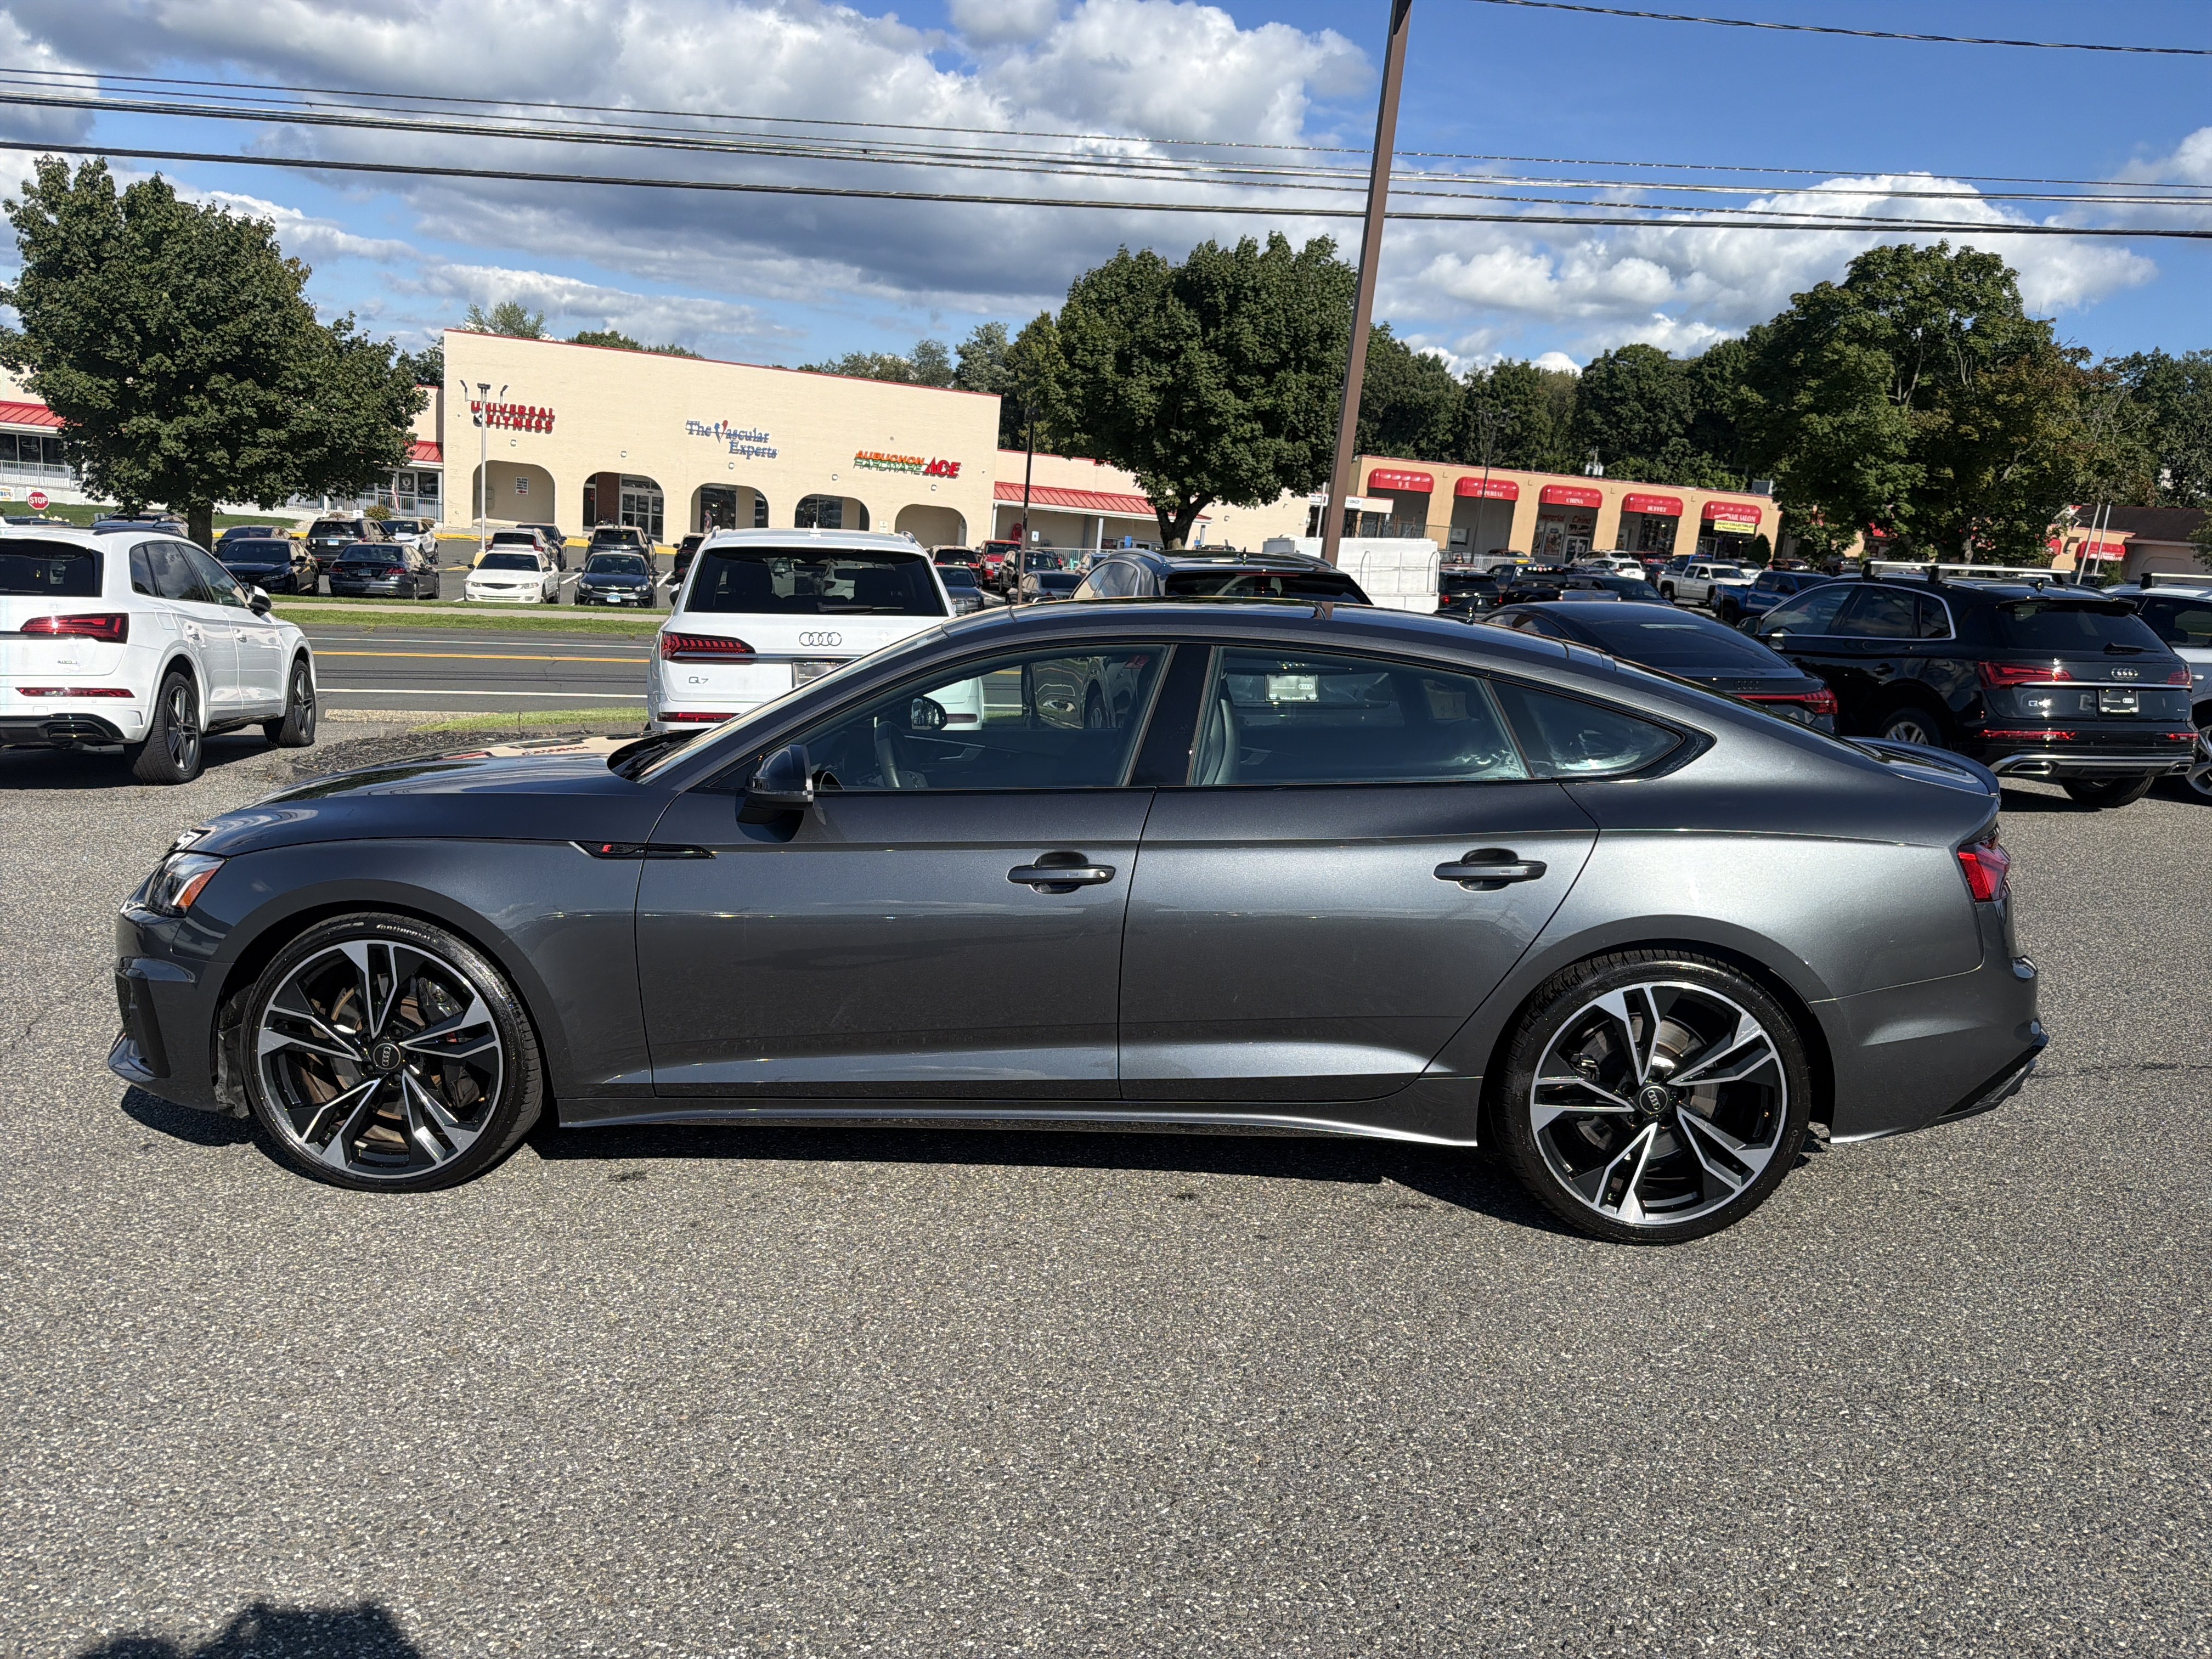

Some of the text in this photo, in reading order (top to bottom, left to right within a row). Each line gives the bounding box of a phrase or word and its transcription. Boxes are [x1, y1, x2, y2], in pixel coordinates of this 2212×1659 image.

[471, 400, 556, 420] UNIVERSAL
[487, 415, 553, 432] FITNESS
[685, 420, 770, 443] The Vascular
[729, 440, 778, 460] Experts
[855, 450, 925, 465] AUBUCHON
[854, 459, 924, 475] HARDWARE
[924, 456, 962, 478] ACE
